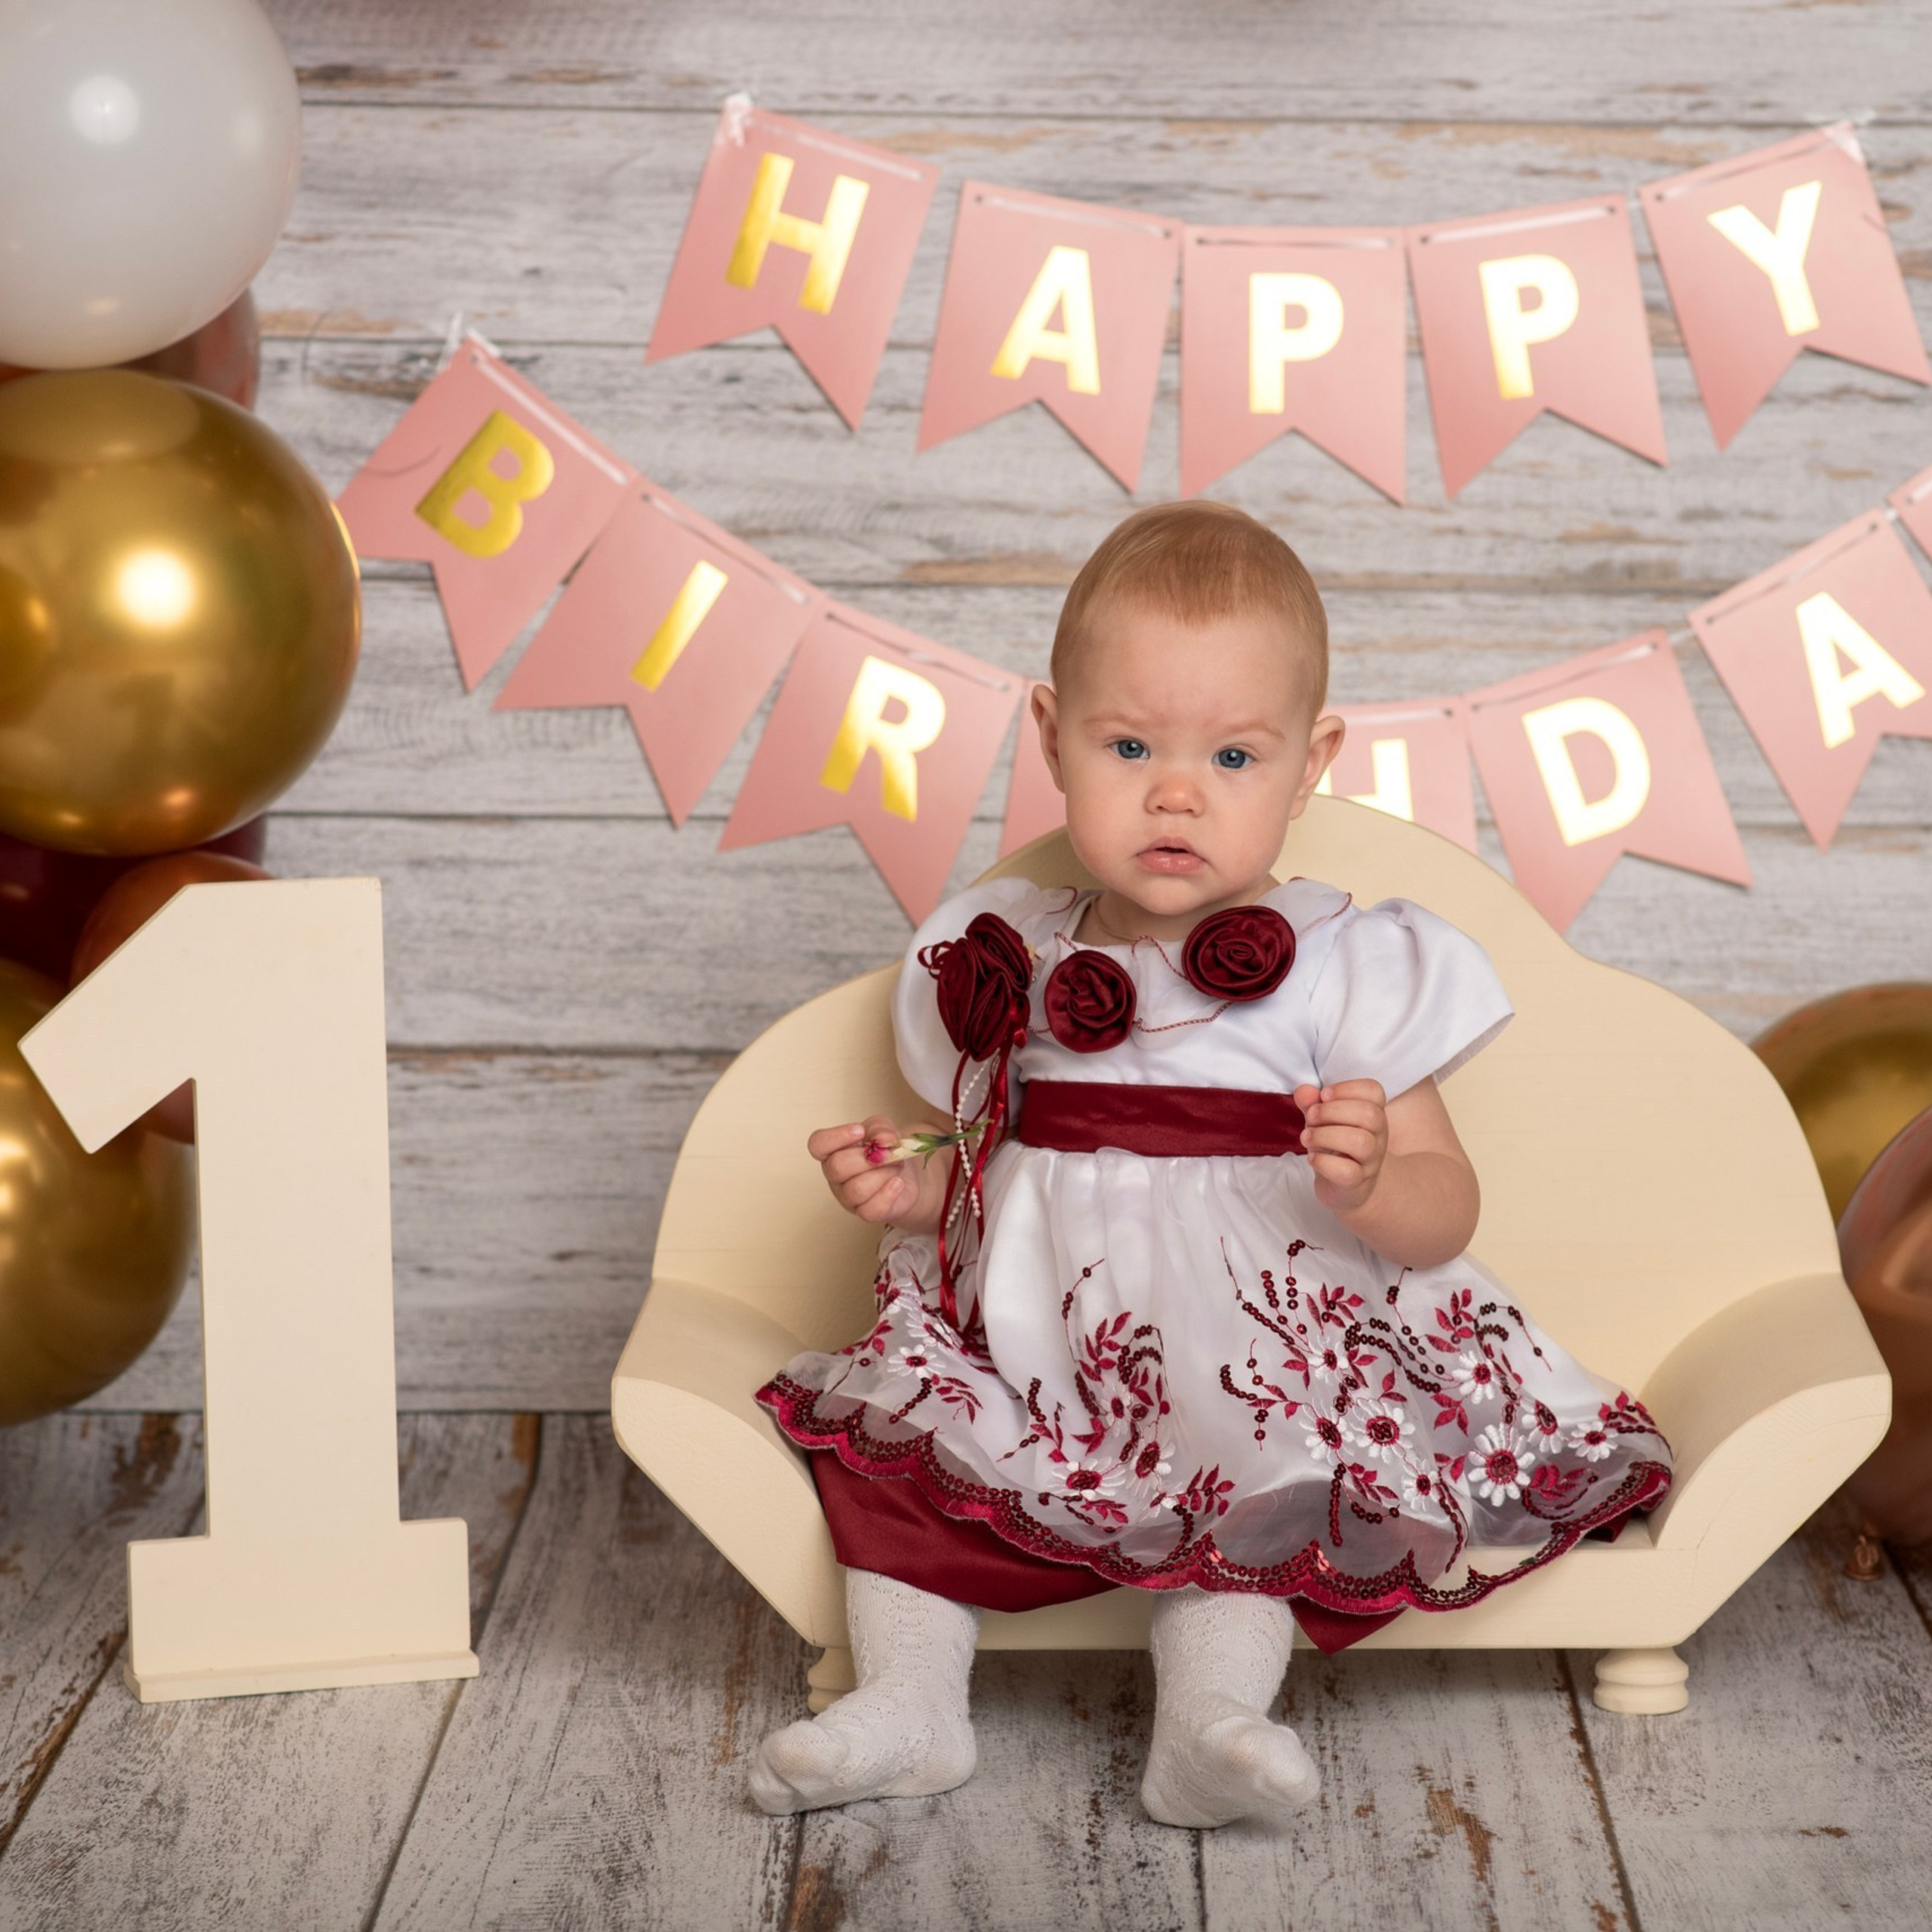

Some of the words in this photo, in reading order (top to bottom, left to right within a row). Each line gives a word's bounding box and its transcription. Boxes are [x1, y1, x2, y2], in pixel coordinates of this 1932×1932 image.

[725, 152, 1822, 415] HAPPY
[415, 409, 1926, 847] BIRDA
[18, 876, 478, 1703] 1
